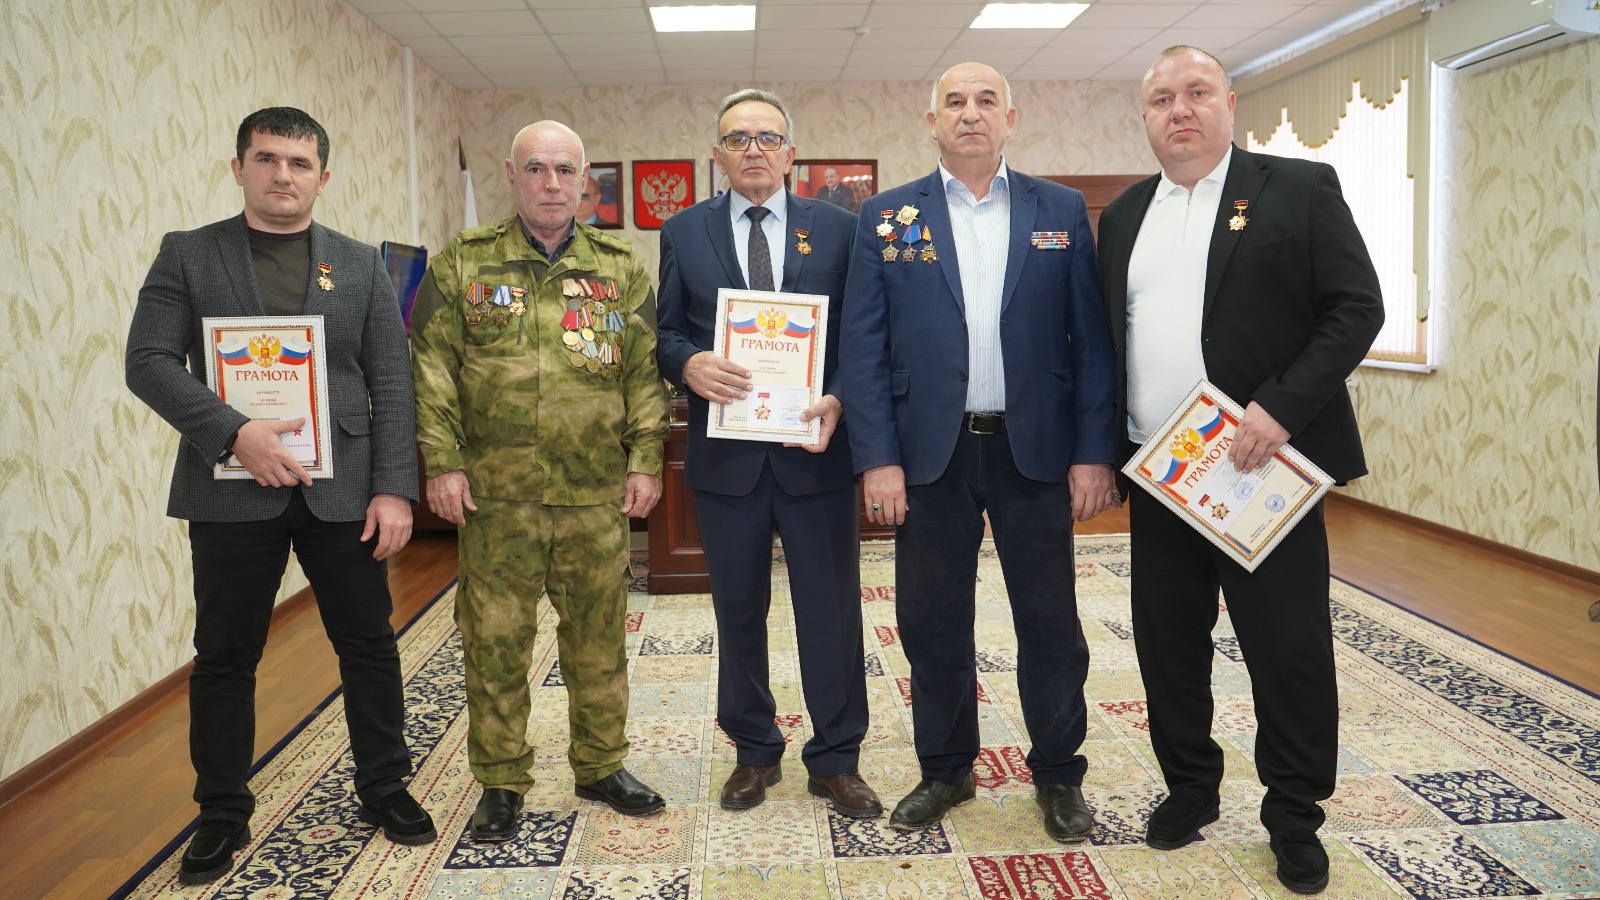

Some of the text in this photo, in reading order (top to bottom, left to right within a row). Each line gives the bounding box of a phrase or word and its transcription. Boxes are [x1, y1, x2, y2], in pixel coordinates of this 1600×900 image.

[741, 338, 800, 353] ГРАМОТА
[235, 370, 299, 381] ГРАМОТА
[1184, 436, 1233, 489] ГРАМОТА
